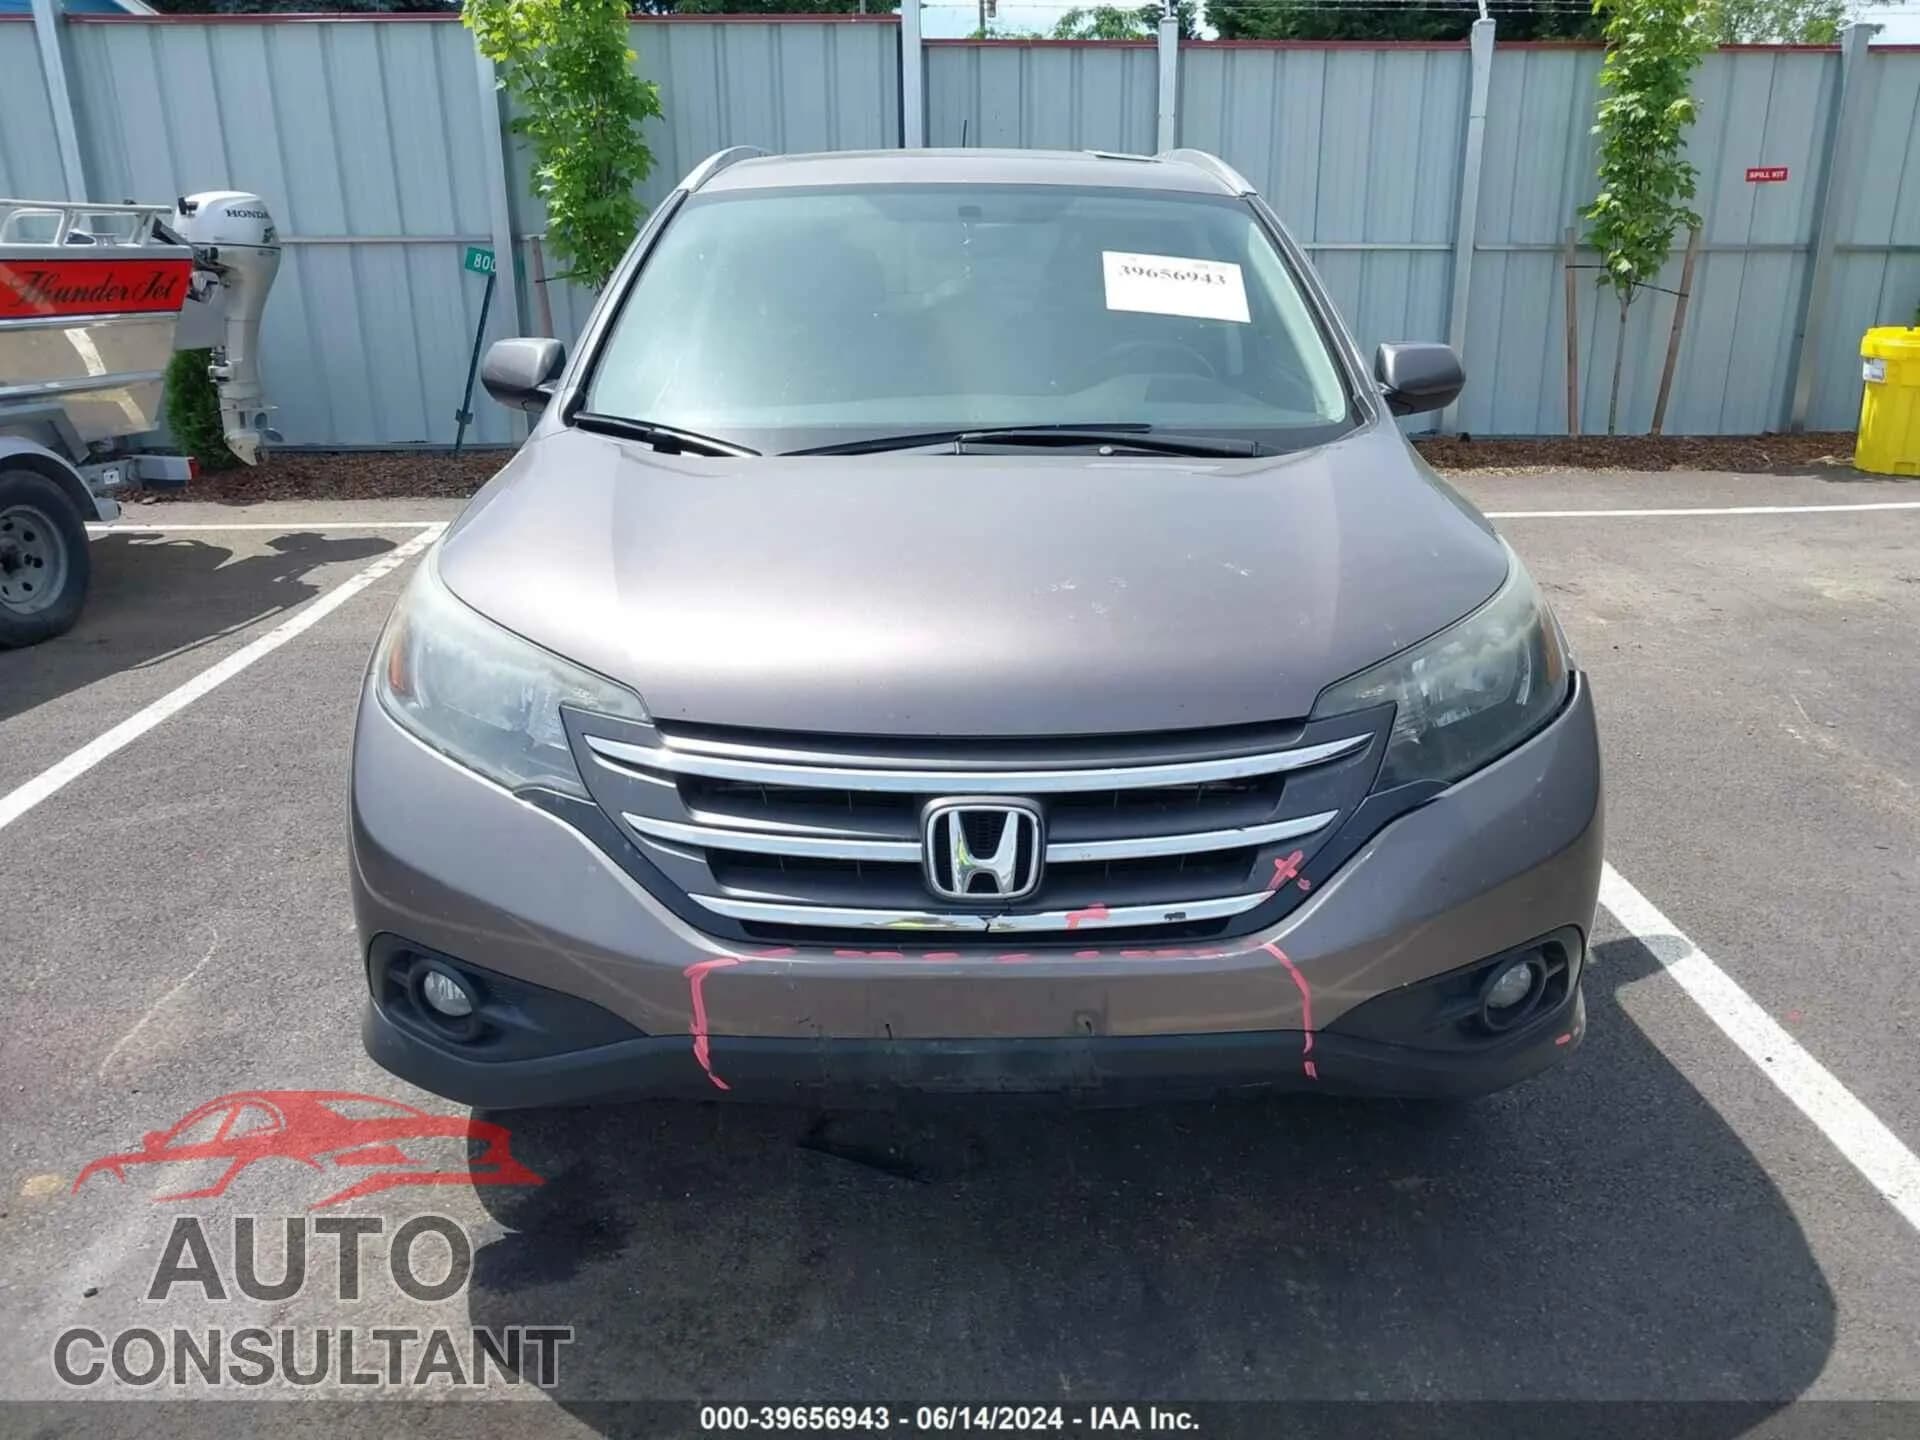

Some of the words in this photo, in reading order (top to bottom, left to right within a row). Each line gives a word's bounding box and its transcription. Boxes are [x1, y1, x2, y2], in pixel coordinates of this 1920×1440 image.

[9, 270, 129, 307] Thunder
[131, 271, 178, 302] Jet
[1119, 264, 1227, 286] 39656943
